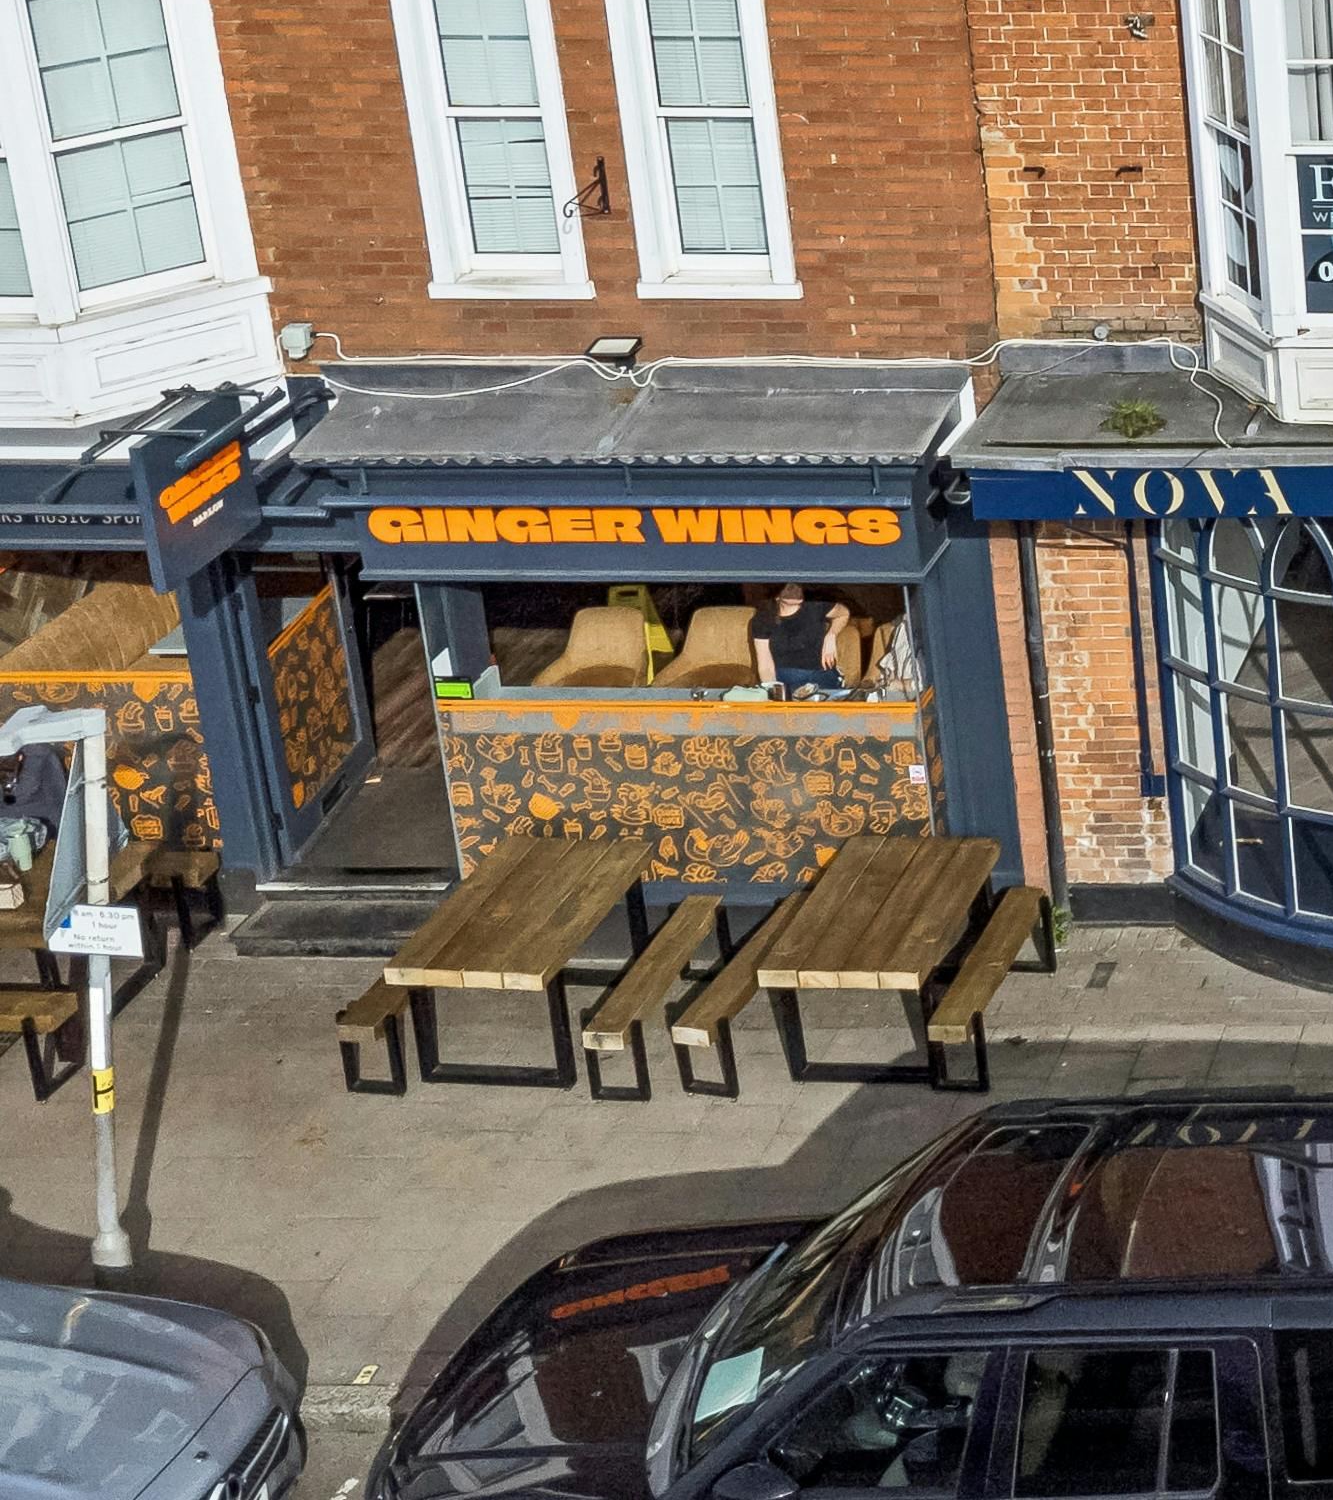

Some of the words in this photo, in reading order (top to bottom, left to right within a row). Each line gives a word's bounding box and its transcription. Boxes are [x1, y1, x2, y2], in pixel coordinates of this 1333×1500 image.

[1072, 468, 1294, 516] NOVA
[367, 507, 646, 544] GINGER
[652, 507, 902, 546] WINGS
